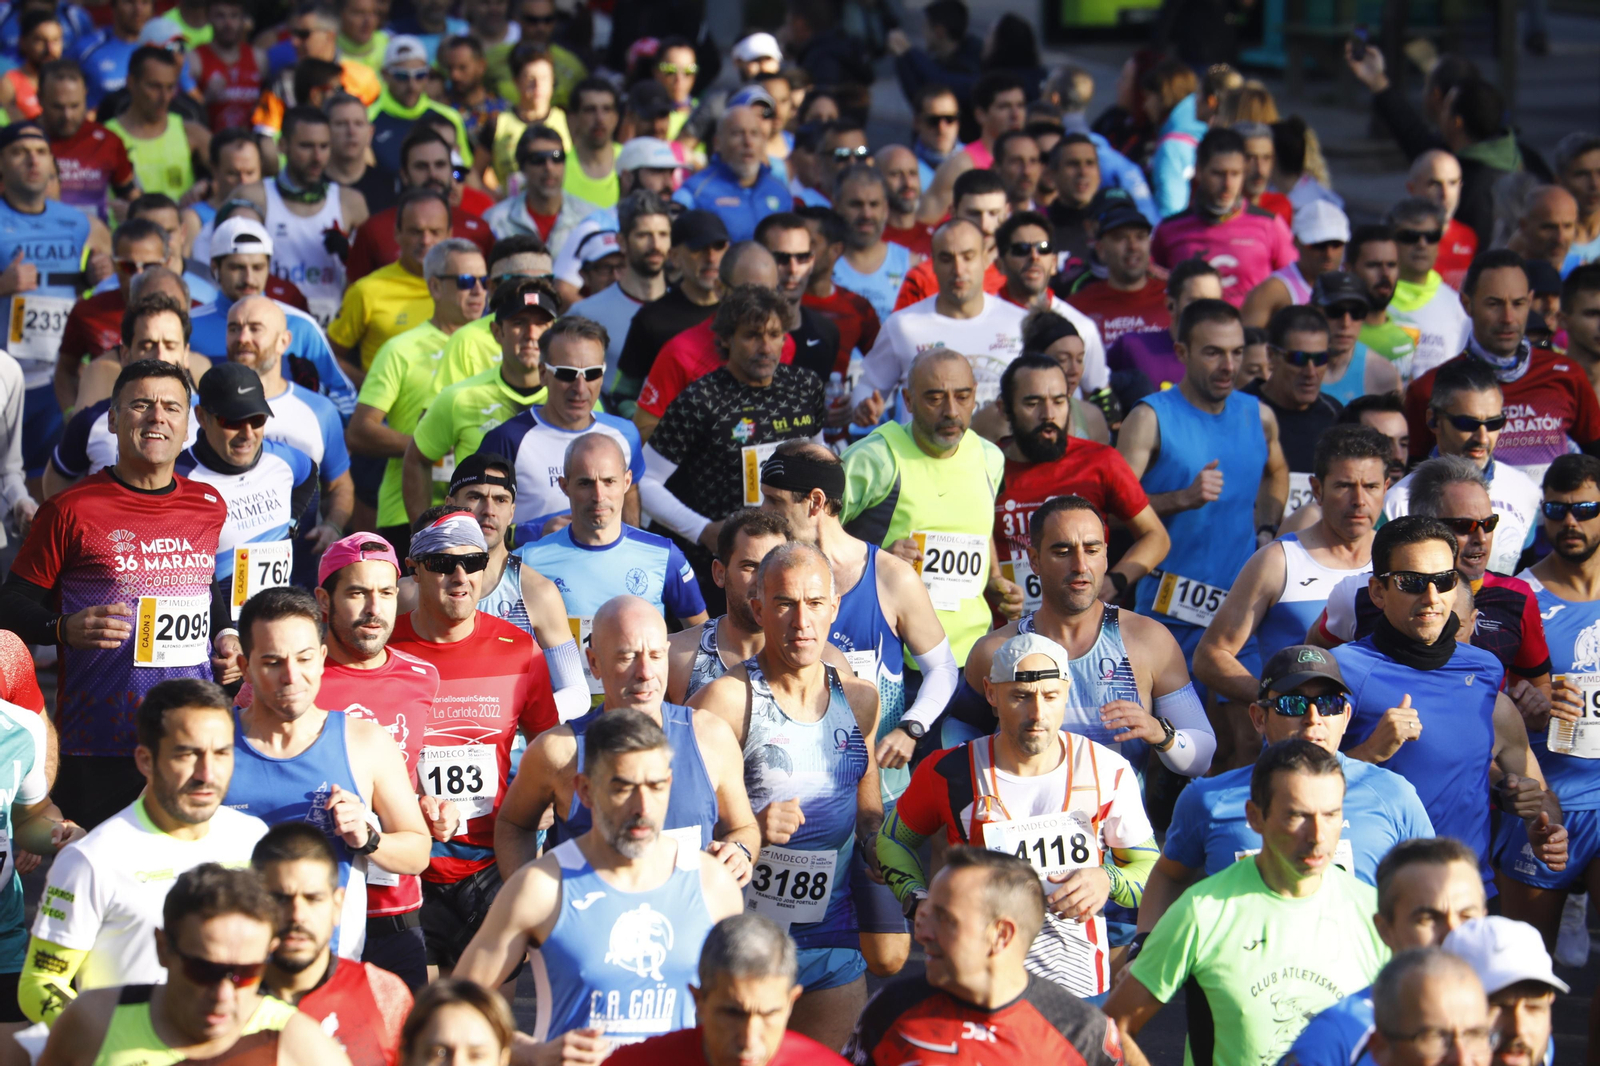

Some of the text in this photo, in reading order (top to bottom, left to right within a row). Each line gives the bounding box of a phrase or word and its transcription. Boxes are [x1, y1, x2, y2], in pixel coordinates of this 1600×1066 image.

[25, 308, 69, 331] 233
[1501, 403, 1536, 419] EDIA
[1496, 435, 1543, 448] ÓRDOBA
[228, 492, 265, 509] UNNERS
[237, 513, 275, 531] HUELVA
[140, 538, 193, 554] MEDIA
[937, 535, 966, 545] IMDECO
[114, 549, 215, 572] 36 MARATÓN
[923, 547, 982, 576] 2000
[145, 574, 199, 587] CÓRDOBA
[258, 559, 289, 586] 762
[169, 599, 200, 607] IMDECO
[1177, 580, 1228, 612] 105
[142, 621, 150, 648] CAJÓN
[155, 611, 208, 641] 2095
[433, 703, 501, 718] La Carlota 2022
[427, 749, 465, 759] IMDECO
[428, 764, 483, 795] 183
[1018, 819, 1058, 832] IMDECO
[770, 850, 809, 864] IMDECO
[1014, 832, 1090, 868] 4118
[752, 864, 828, 901] 3188
[1251, 967, 1345, 1001] CLUB ATLETISMO
